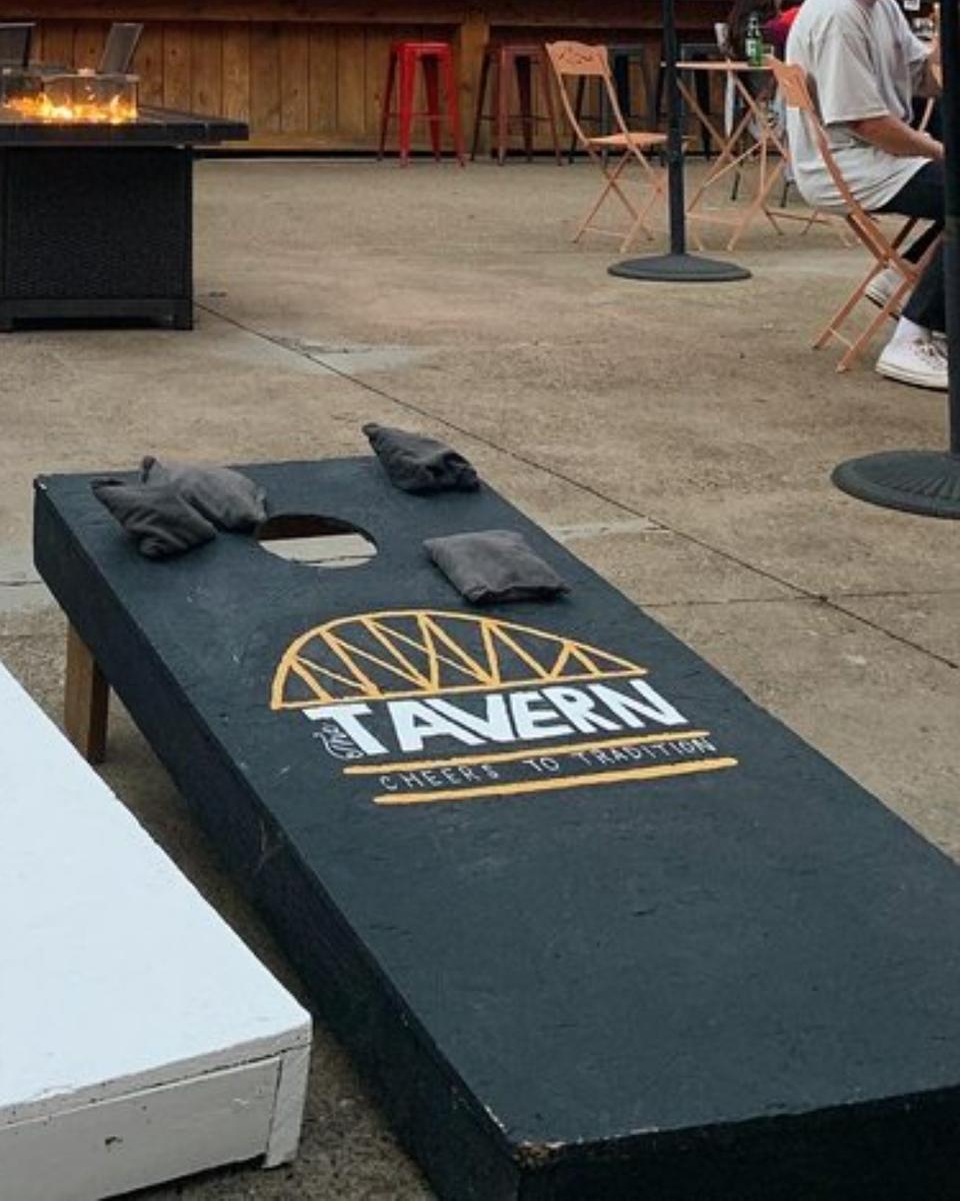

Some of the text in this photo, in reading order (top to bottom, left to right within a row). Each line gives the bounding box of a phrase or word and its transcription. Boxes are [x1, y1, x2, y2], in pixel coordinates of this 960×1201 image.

[303, 679, 689, 756] TAVERN
[378, 735, 717, 791] CHEERS TO TRADITION
